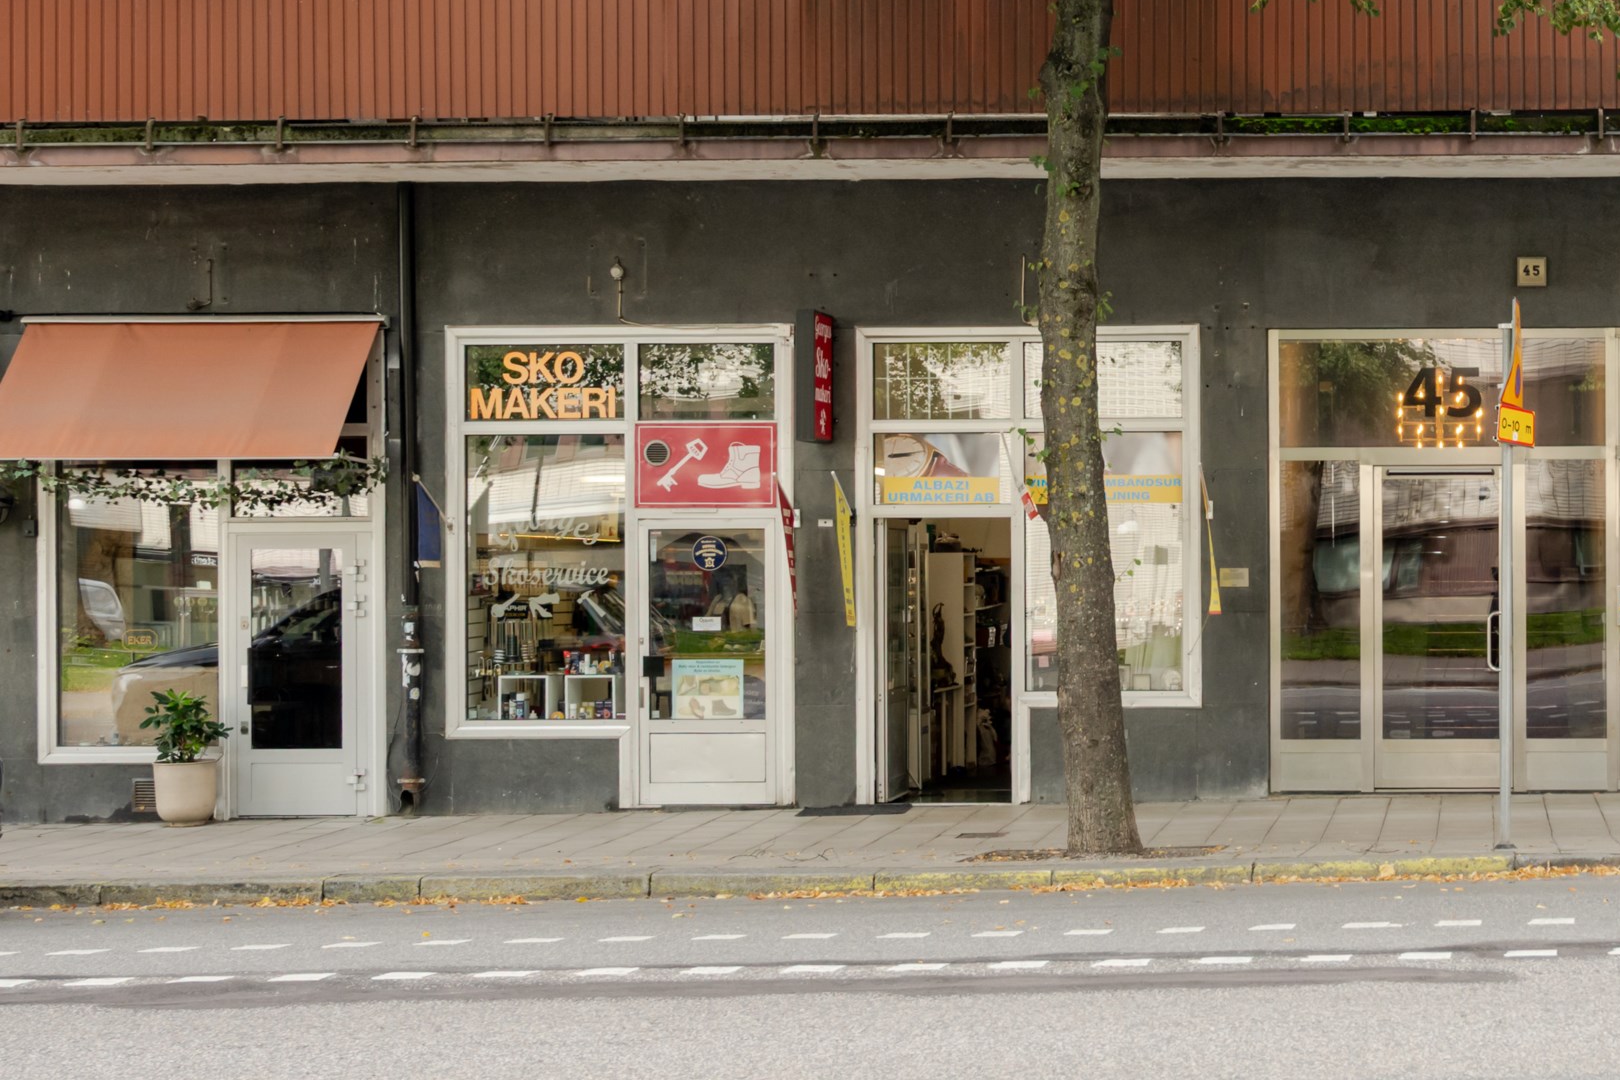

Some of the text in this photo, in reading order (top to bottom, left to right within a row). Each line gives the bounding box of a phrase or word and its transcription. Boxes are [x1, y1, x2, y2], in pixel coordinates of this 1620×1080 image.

[1522, 265, 1540, 276] 45
[502, 350, 584, 385] SKO
[1402, 366, 1482, 417] 45
[470, 387, 616, 420] MAKERI
[1501, 417, 1532, 434] 0-10 m
[913, 479, 969, 491] ALBAZI
[1105, 478, 1182, 487] MBANDSUR
[888, 491, 995, 502] URMAKERI AB
[482, 558, 611, 590] Skoservice
